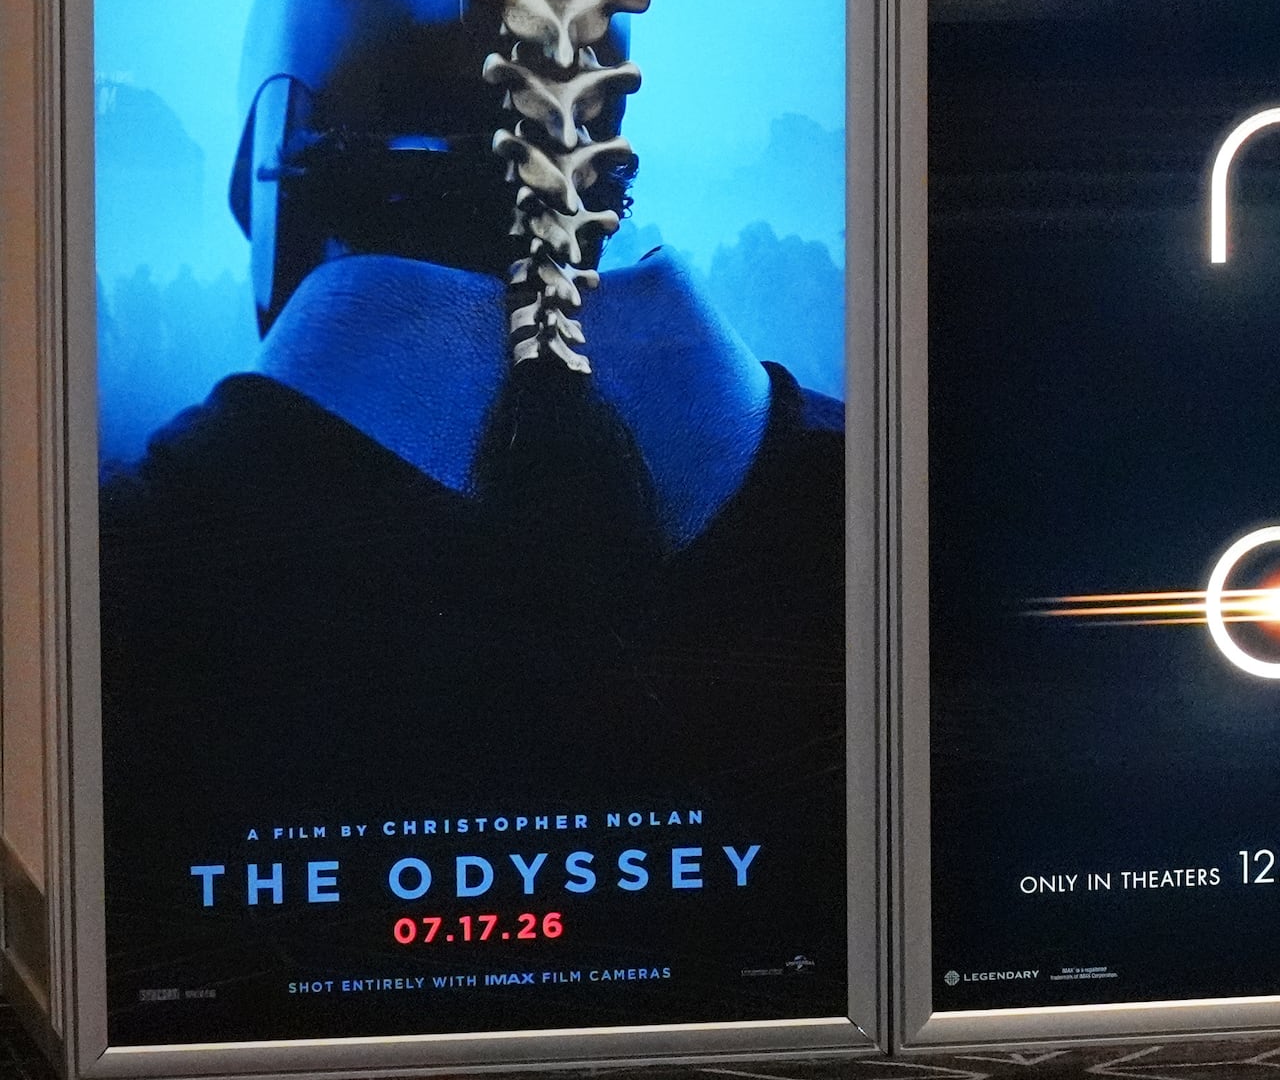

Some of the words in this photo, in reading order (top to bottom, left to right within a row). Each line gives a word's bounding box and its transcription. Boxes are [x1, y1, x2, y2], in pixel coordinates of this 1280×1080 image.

[247, 828, 260, 842] A
[273, 825, 327, 840] FILM
[340, 824, 369, 838] BY
[382, 814, 589, 837] CHRISTOPHER
[606, 809, 704, 828] NOLAN
[190, 859, 343, 908] THE
[387, 844, 764, 901] ODYSSEY
[1019, 874, 1079, 896] ONLY
[1087, 872, 1111, 892] IN
[1120, 866, 1221, 892] THEATERS
[392, 910, 566, 946] 07.17.26
[288, 980, 334, 994] SHOT
[341, 976, 425, 992] ENTIRELY
[432, 975, 478, 989] WITH
[484, 972, 536, 986] IMAX
[542, 970, 582, 984] FILM
[589, 967, 672, 982] CAMERAS
[963, 970, 1040, 982] LEGENDARY
